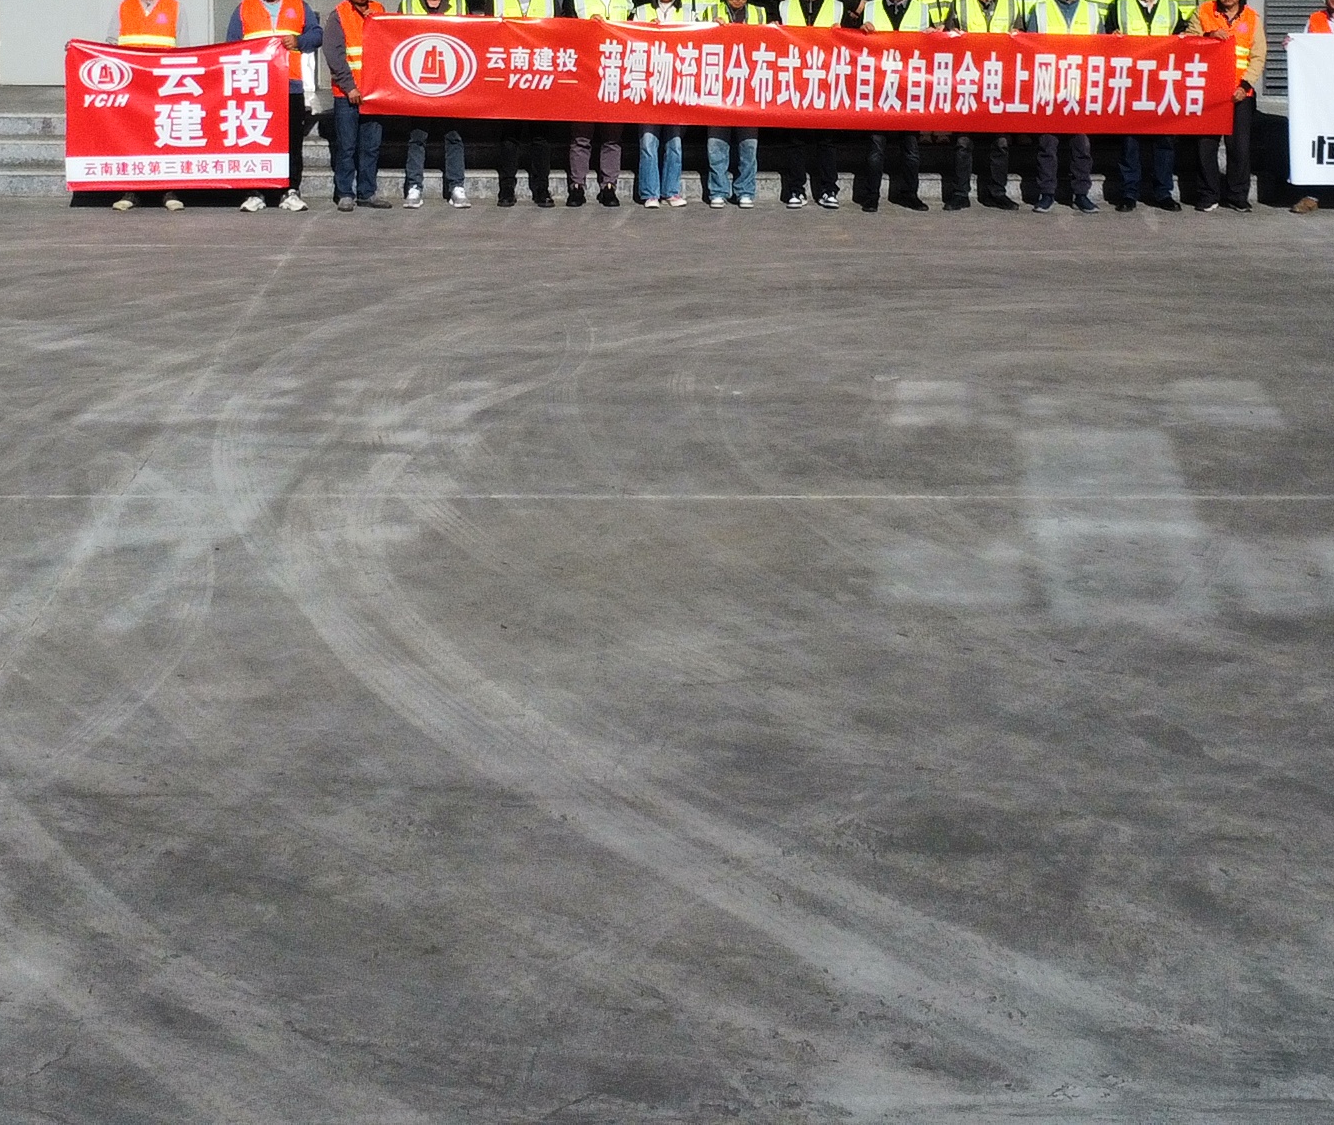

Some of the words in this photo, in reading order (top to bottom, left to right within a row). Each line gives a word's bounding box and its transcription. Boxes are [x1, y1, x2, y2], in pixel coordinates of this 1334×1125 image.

[152, 49, 272, 97] 云南
[485, 46, 578, 73] 云南建投
[506, 74, 555, 90] YCIH
[597, 38, 1208, 116] 蒲缥物流园分布式光伏自发自用余电上网项目开工大吉
[83, 94, 130, 108] YCIH
[154, 100, 273, 148] 建投
[84, 159, 273, 176] 云南建投第三建设有限公司
